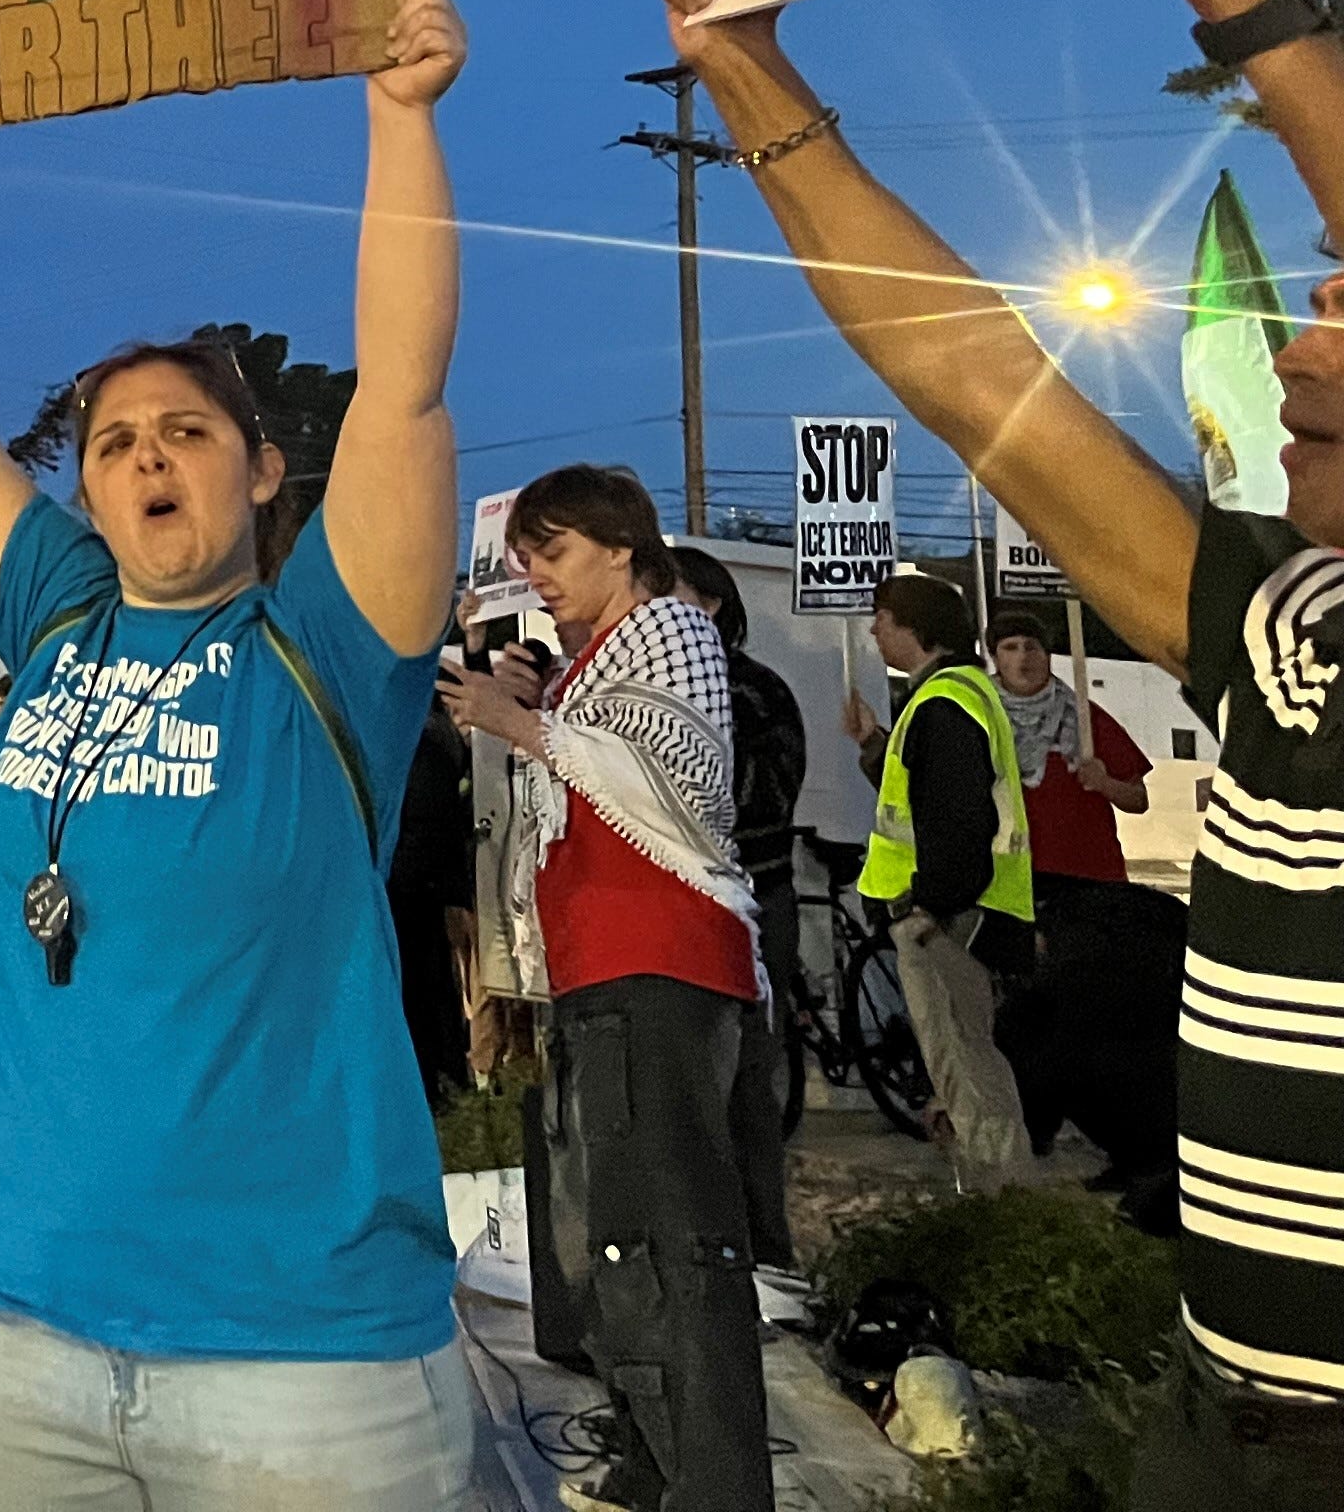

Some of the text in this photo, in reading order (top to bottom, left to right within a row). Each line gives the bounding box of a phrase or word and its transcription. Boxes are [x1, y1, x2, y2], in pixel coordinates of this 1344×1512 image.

[800, 424, 889, 504] STOP
[800, 521, 893, 558] ICE TERROR
[157, 713, 220, 759] WHO
[102, 752, 220, 798] CAPITOL
